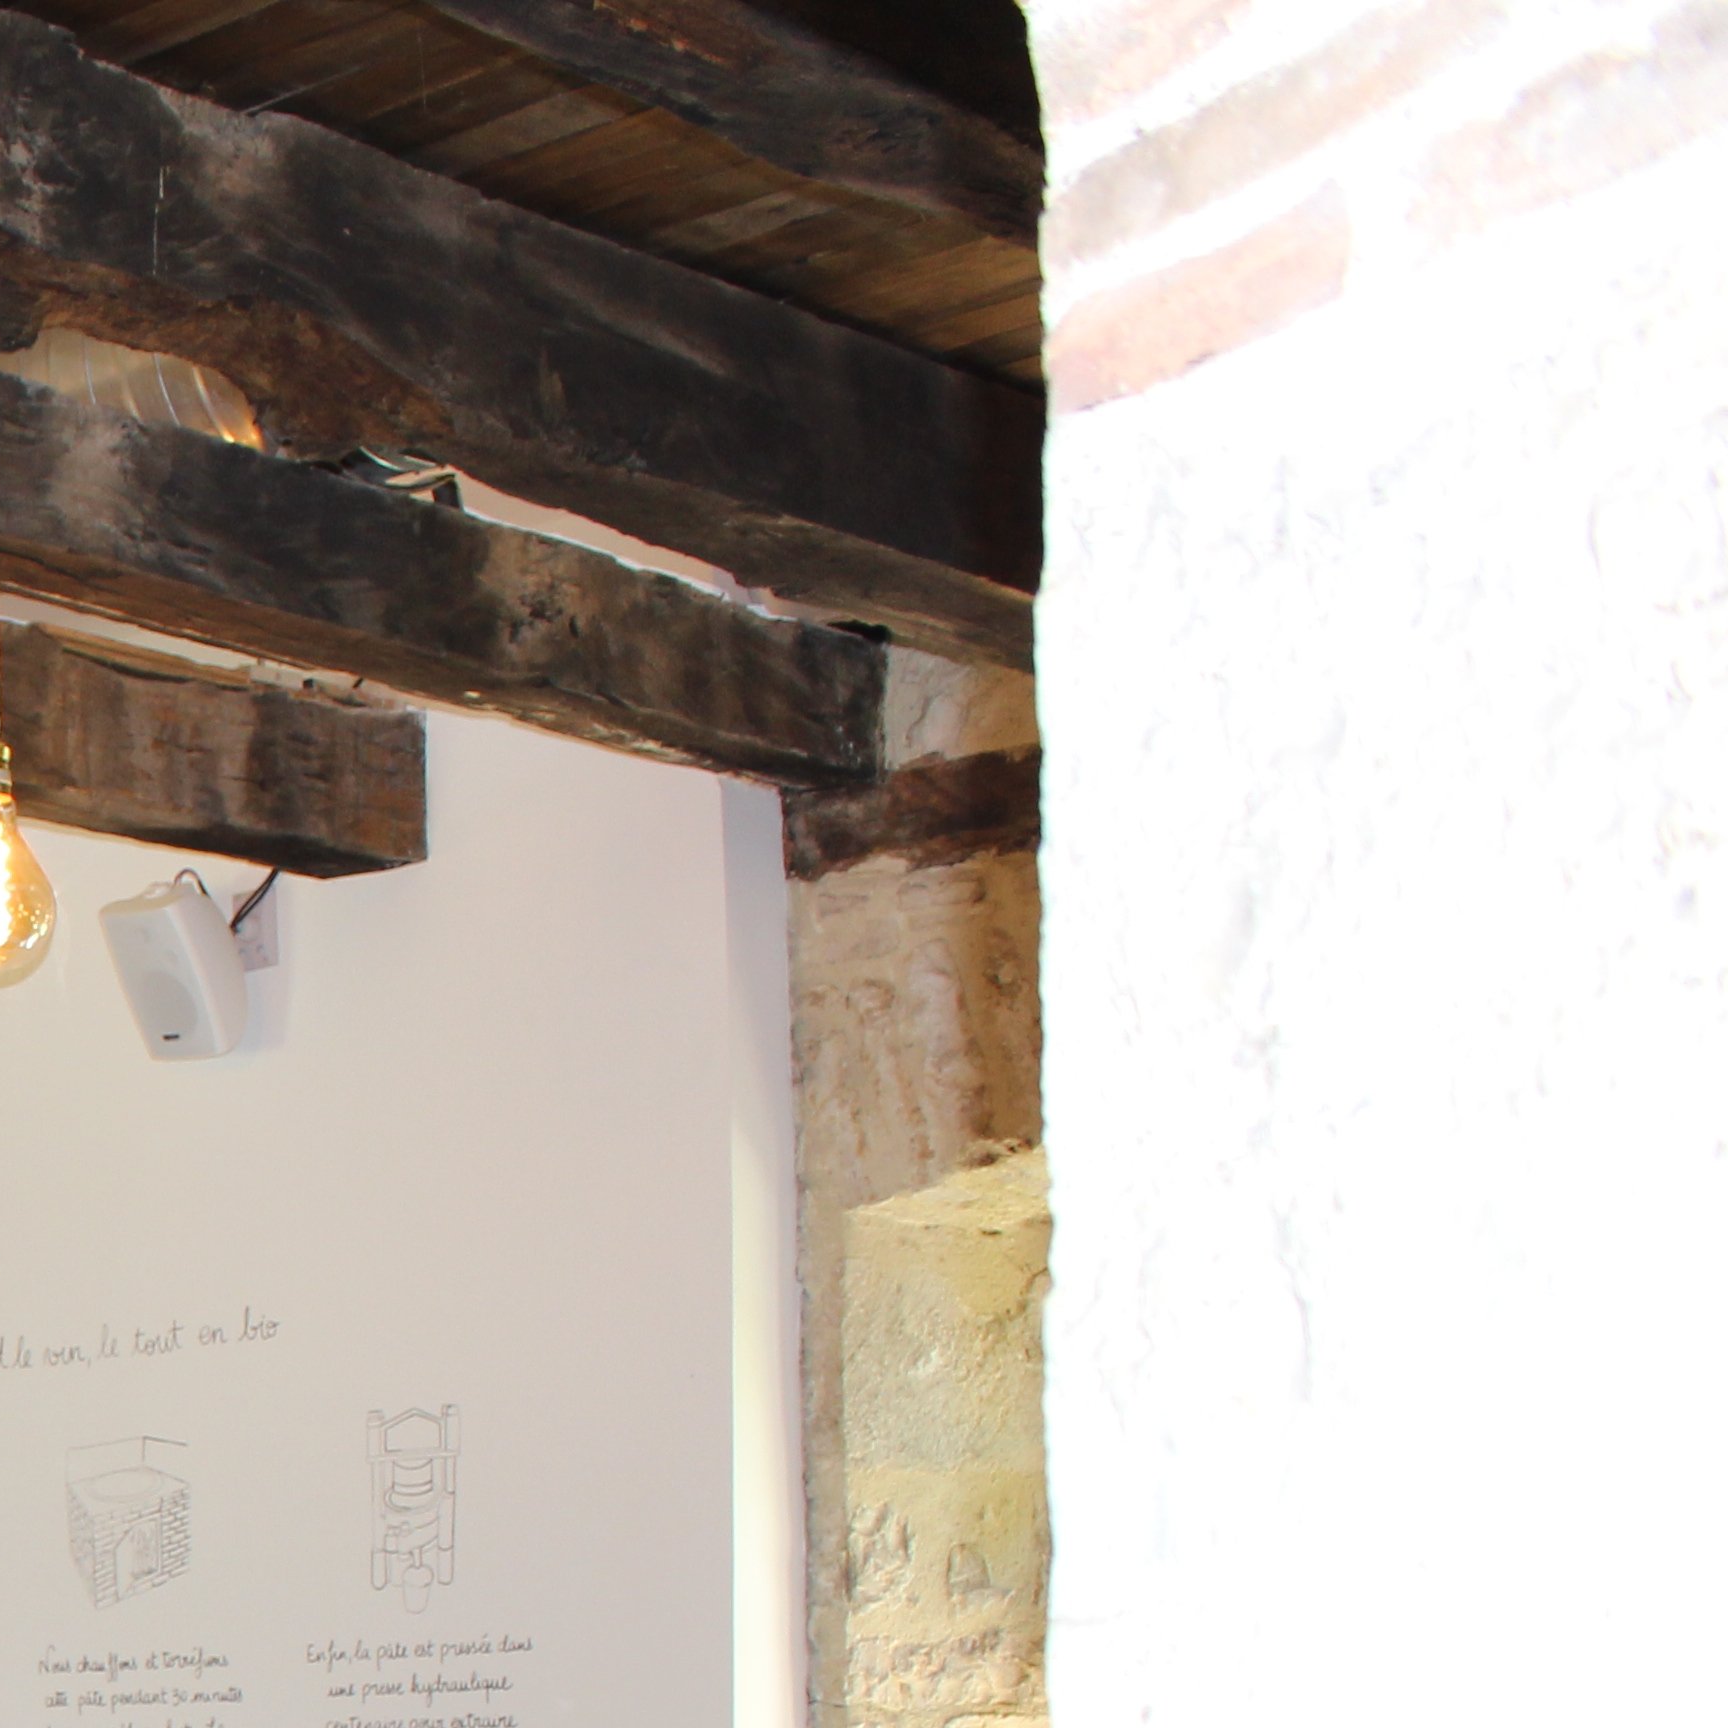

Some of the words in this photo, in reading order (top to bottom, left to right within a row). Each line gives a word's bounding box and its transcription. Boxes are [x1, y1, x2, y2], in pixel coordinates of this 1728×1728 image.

[14, 1335, 33, 1369] le
[97, 1322, 120, 1359] le
[131, 1319, 184, 1356] tout
[197, 1324, 228, 1347] en
[238, 1305, 282, 1342] bio
[38, 1644, 71, 1674] Nous
[76, 1652, 138, 1683] chauffons
[146, 1651, 159, 1670] et
[354, 1639, 371, 1660] la
[376, 1641, 408, 1672] pâte
[413, 1641, 434, 1658] est
[440, 1633, 492, 1664] pressée
[498, 1634, 533, 1653] dans
[78, 1691, 106, 1715] pâte
[111, 1688, 168, 1714] pendant
[172, 1688, 187, 1706] 30
[191, 1686, 243, 1704] minutes
[327, 1682, 355, 1698] une
[361, 1682, 405, 1705] presse
[410, 1670, 513, 1709] hydraulique
